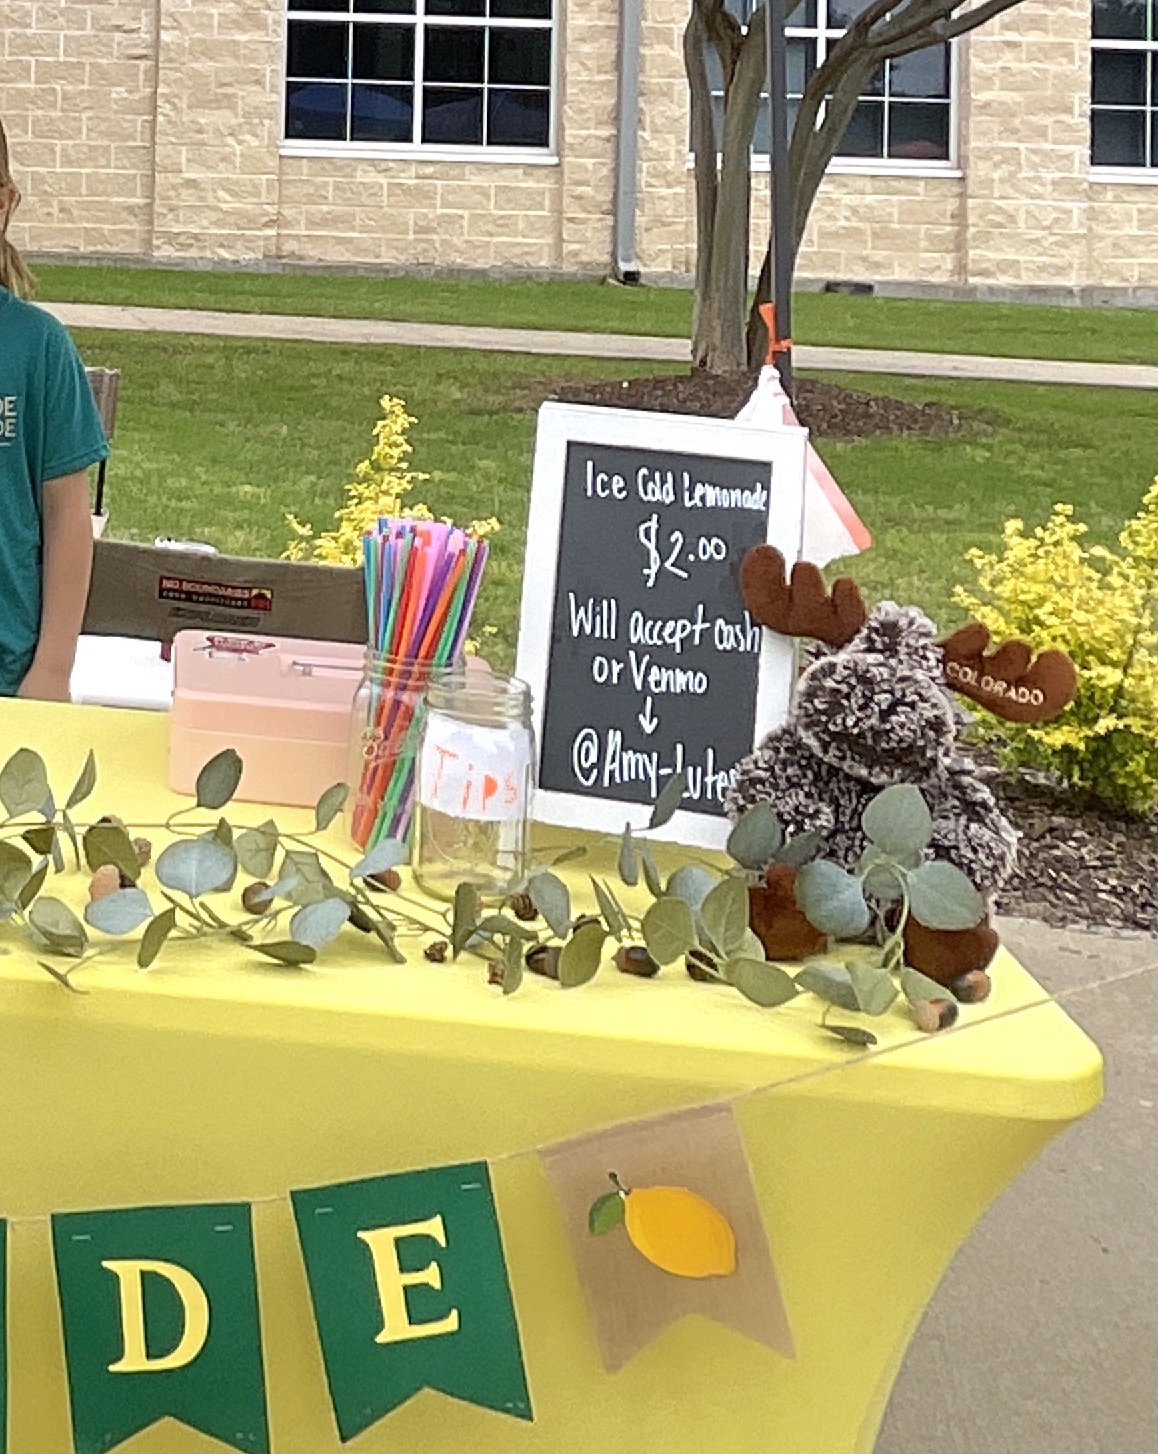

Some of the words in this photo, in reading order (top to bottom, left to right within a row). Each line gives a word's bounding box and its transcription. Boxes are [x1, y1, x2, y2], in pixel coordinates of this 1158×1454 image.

[586, 460, 628, 499] Ice
[637, 467, 676, 505] Cold
[683, 471, 768, 511] Lemonade
[638, 512, 728, 588] $2.00
[569, 592, 617, 639] Will
[629, 603, 711, 654] accept
[714, 610, 761, 653] cash
[592, 655, 624, 685] or
[628, 650, 708, 694] Venmo
[946, 661, 1044, 706] COLORADO
